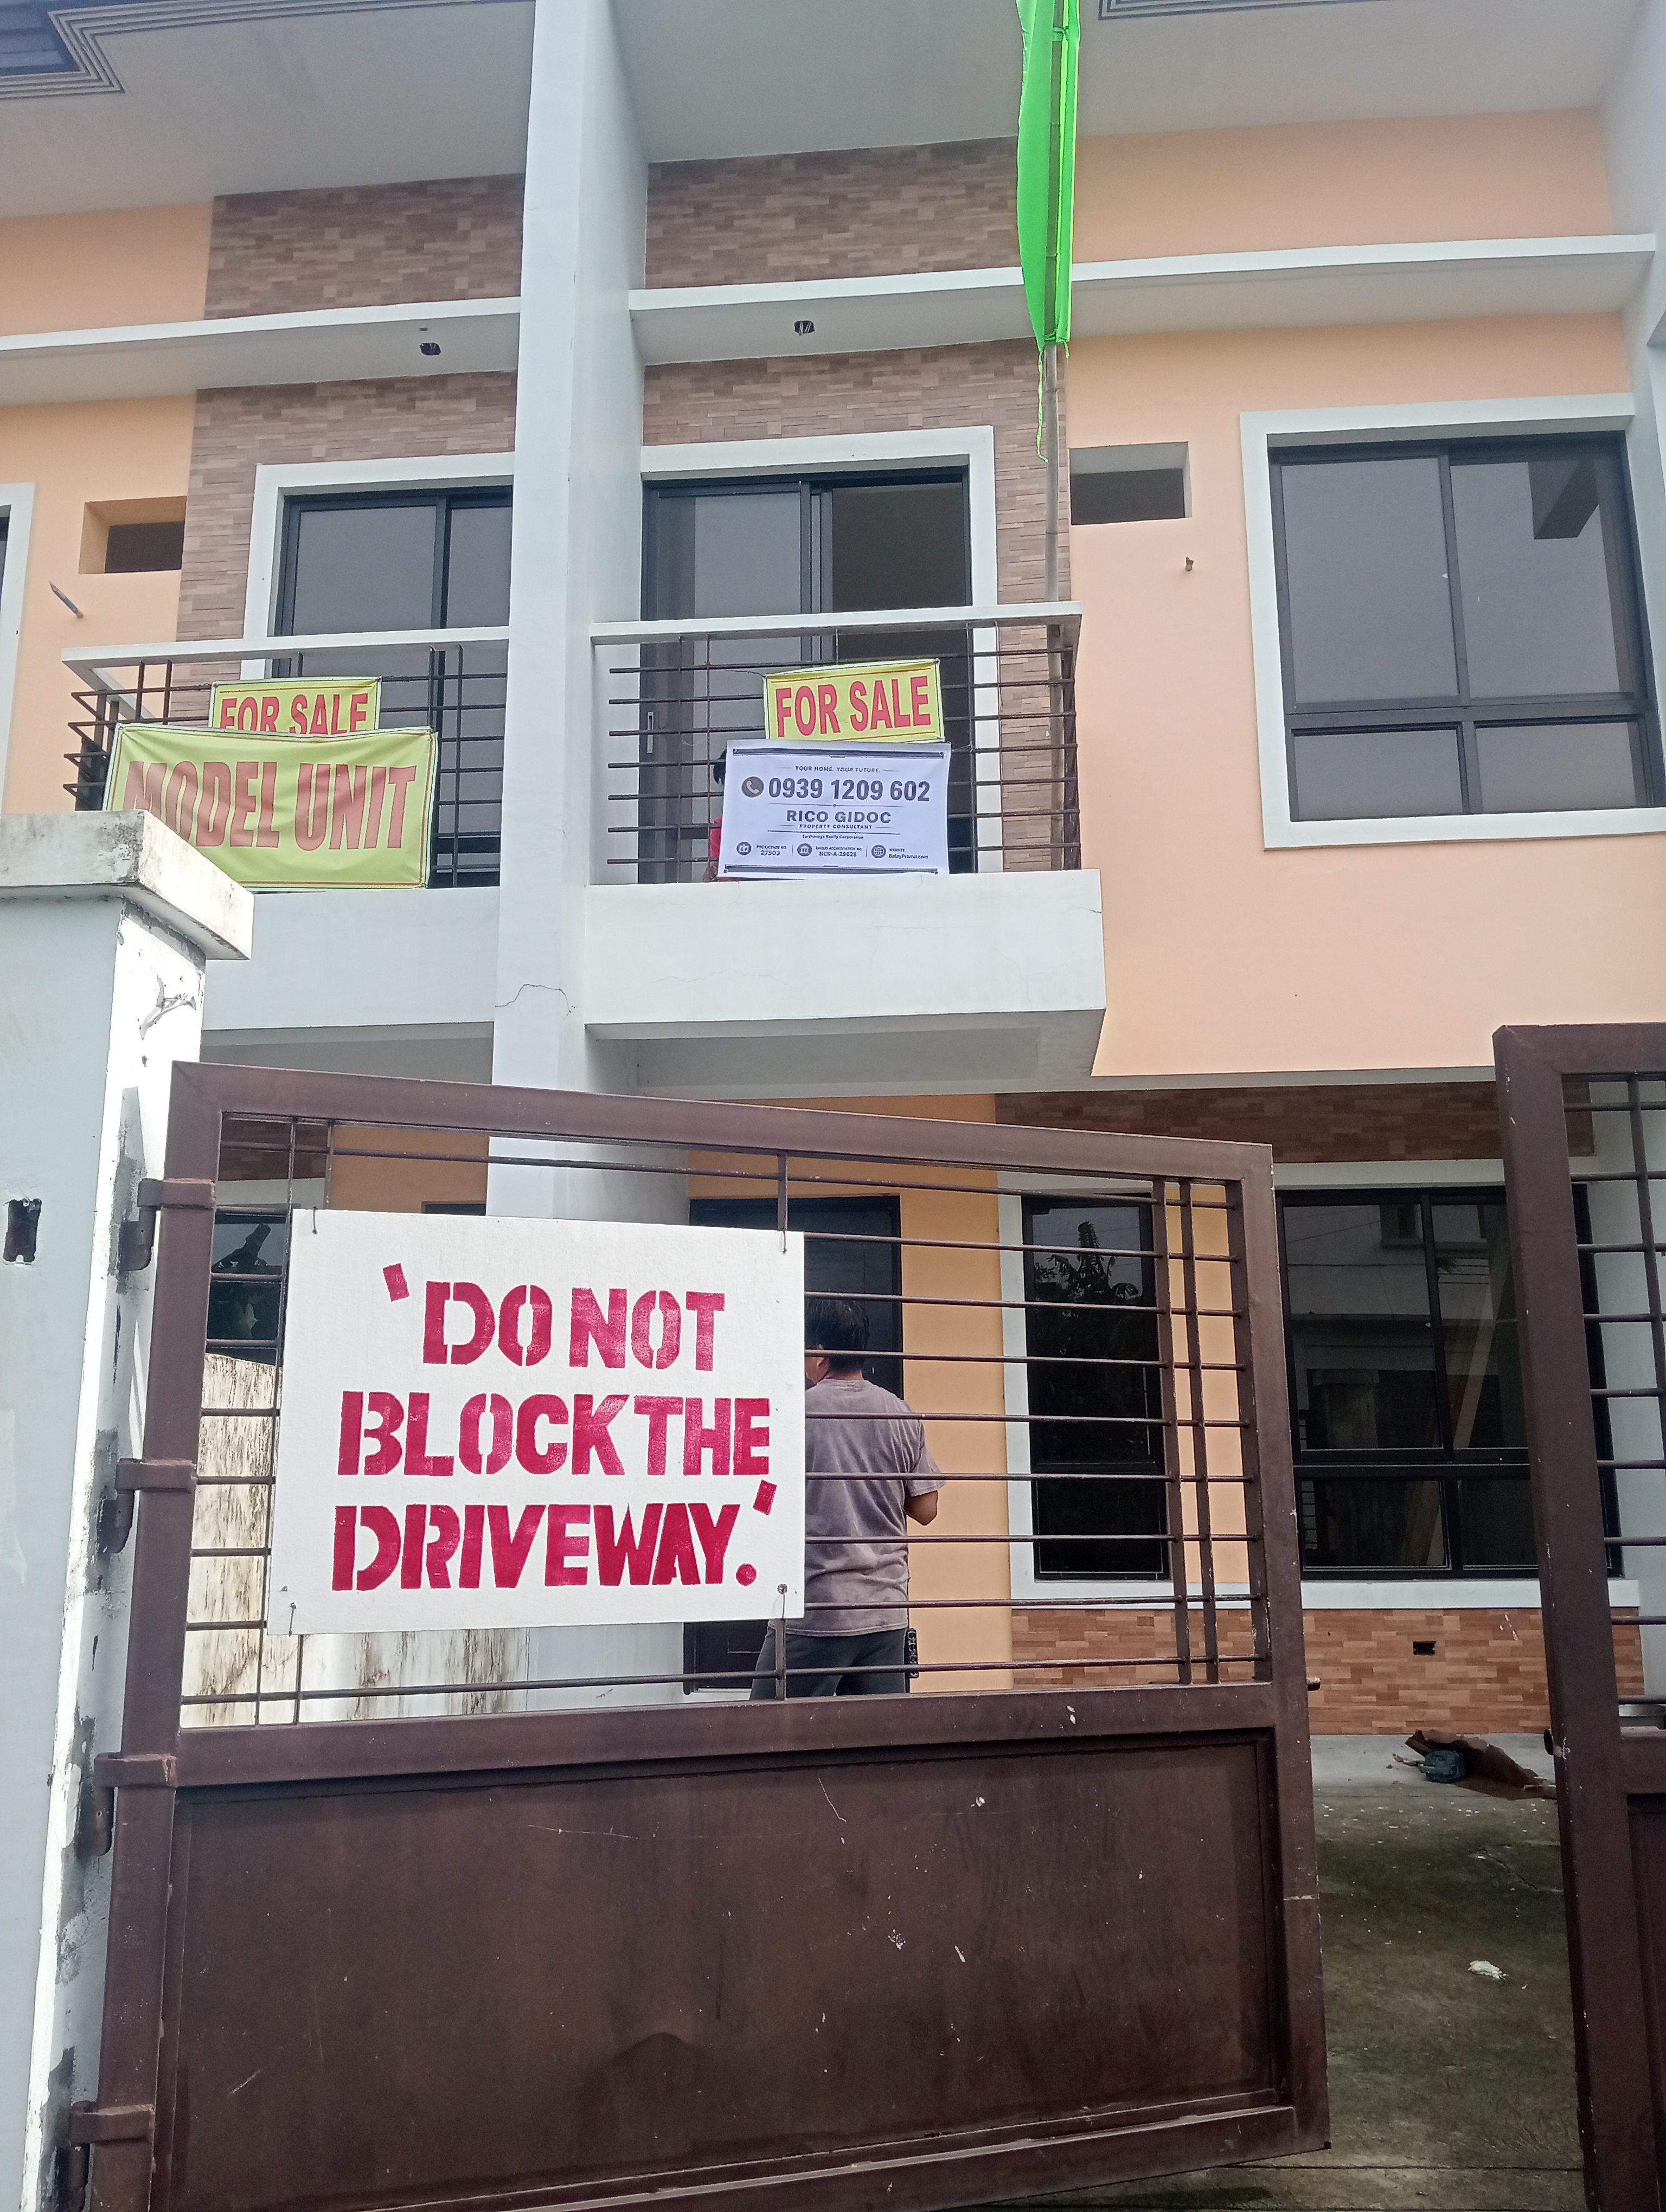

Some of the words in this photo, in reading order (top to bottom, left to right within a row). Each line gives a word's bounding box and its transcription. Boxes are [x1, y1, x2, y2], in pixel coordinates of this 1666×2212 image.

[220, 696, 279, 732] FOR
[289, 693, 369, 735] SALE
[776, 684, 841, 738] FOR
[849, 676, 931, 731] SALE
[123, 761, 280, 848] MODEL
[294, 763, 417, 851] UNIT
[769, 777, 823, 799] 0939
[831, 779, 883, 800] 1209
[890, 781, 931, 801] 602
[786, 809, 828, 822] RICO
[835, 811, 891, 824] GIDOC
[569, 1288, 725, 1371] NOT
[337, 1391, 630, 1476] BLOCK
[634, 1396, 771, 1476] THE
